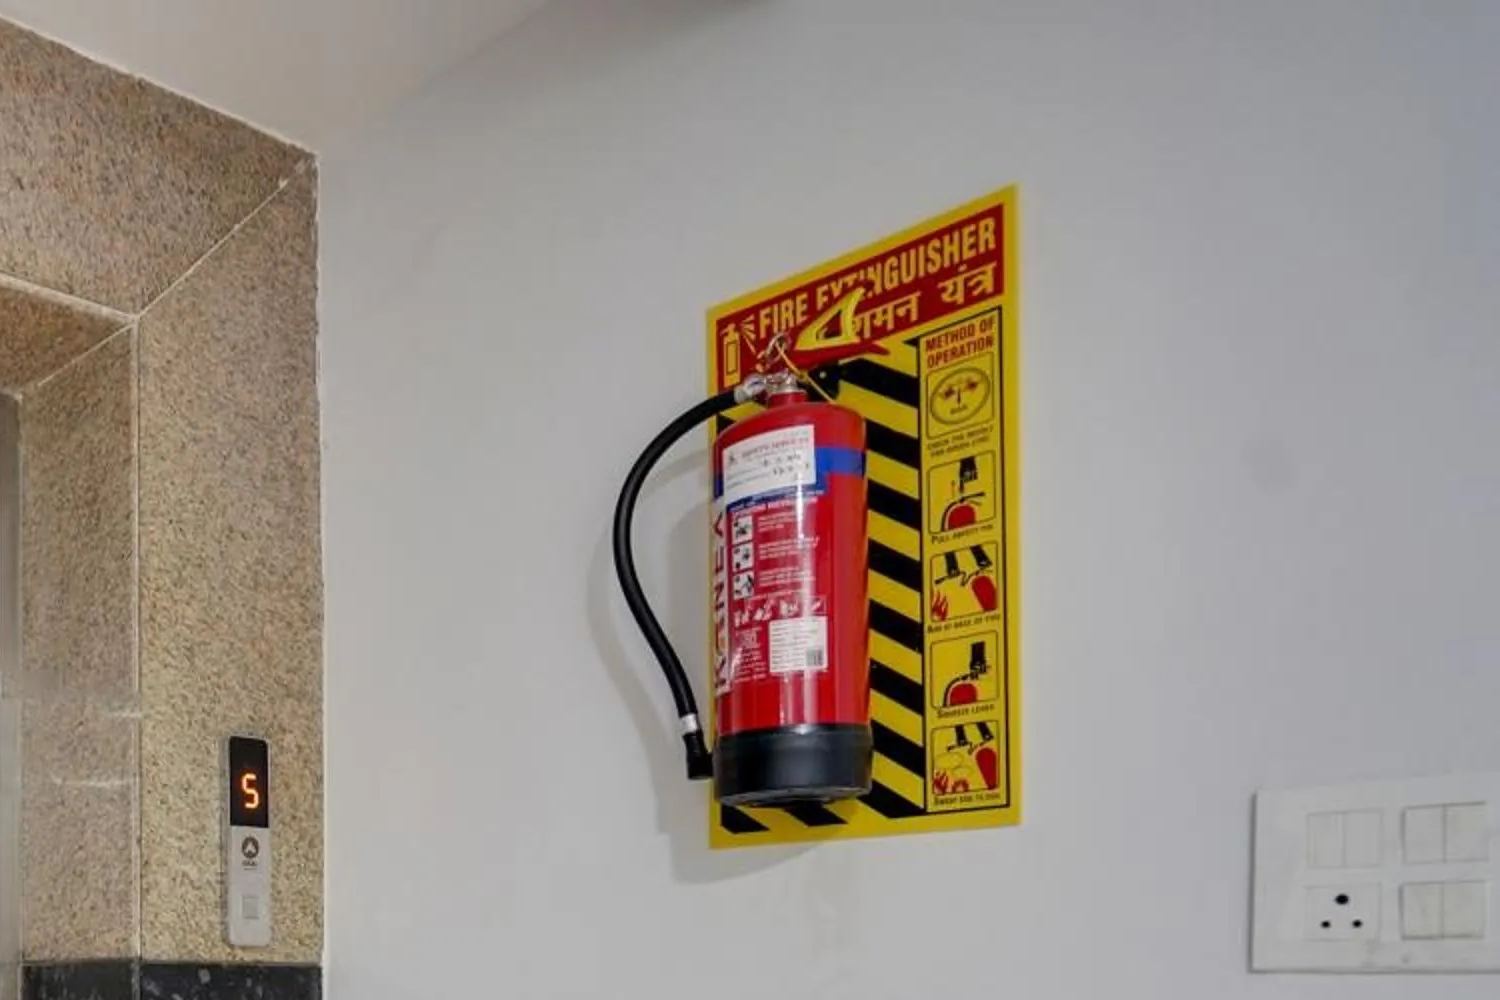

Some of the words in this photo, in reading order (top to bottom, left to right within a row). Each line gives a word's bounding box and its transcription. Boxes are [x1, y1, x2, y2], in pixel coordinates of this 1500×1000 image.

[760, 291, 808, 339] FIRE
[925, 321, 975, 352] METHOD
[979, 315, 995, 333] OF
[927, 335, 994, 369] OPERATION
